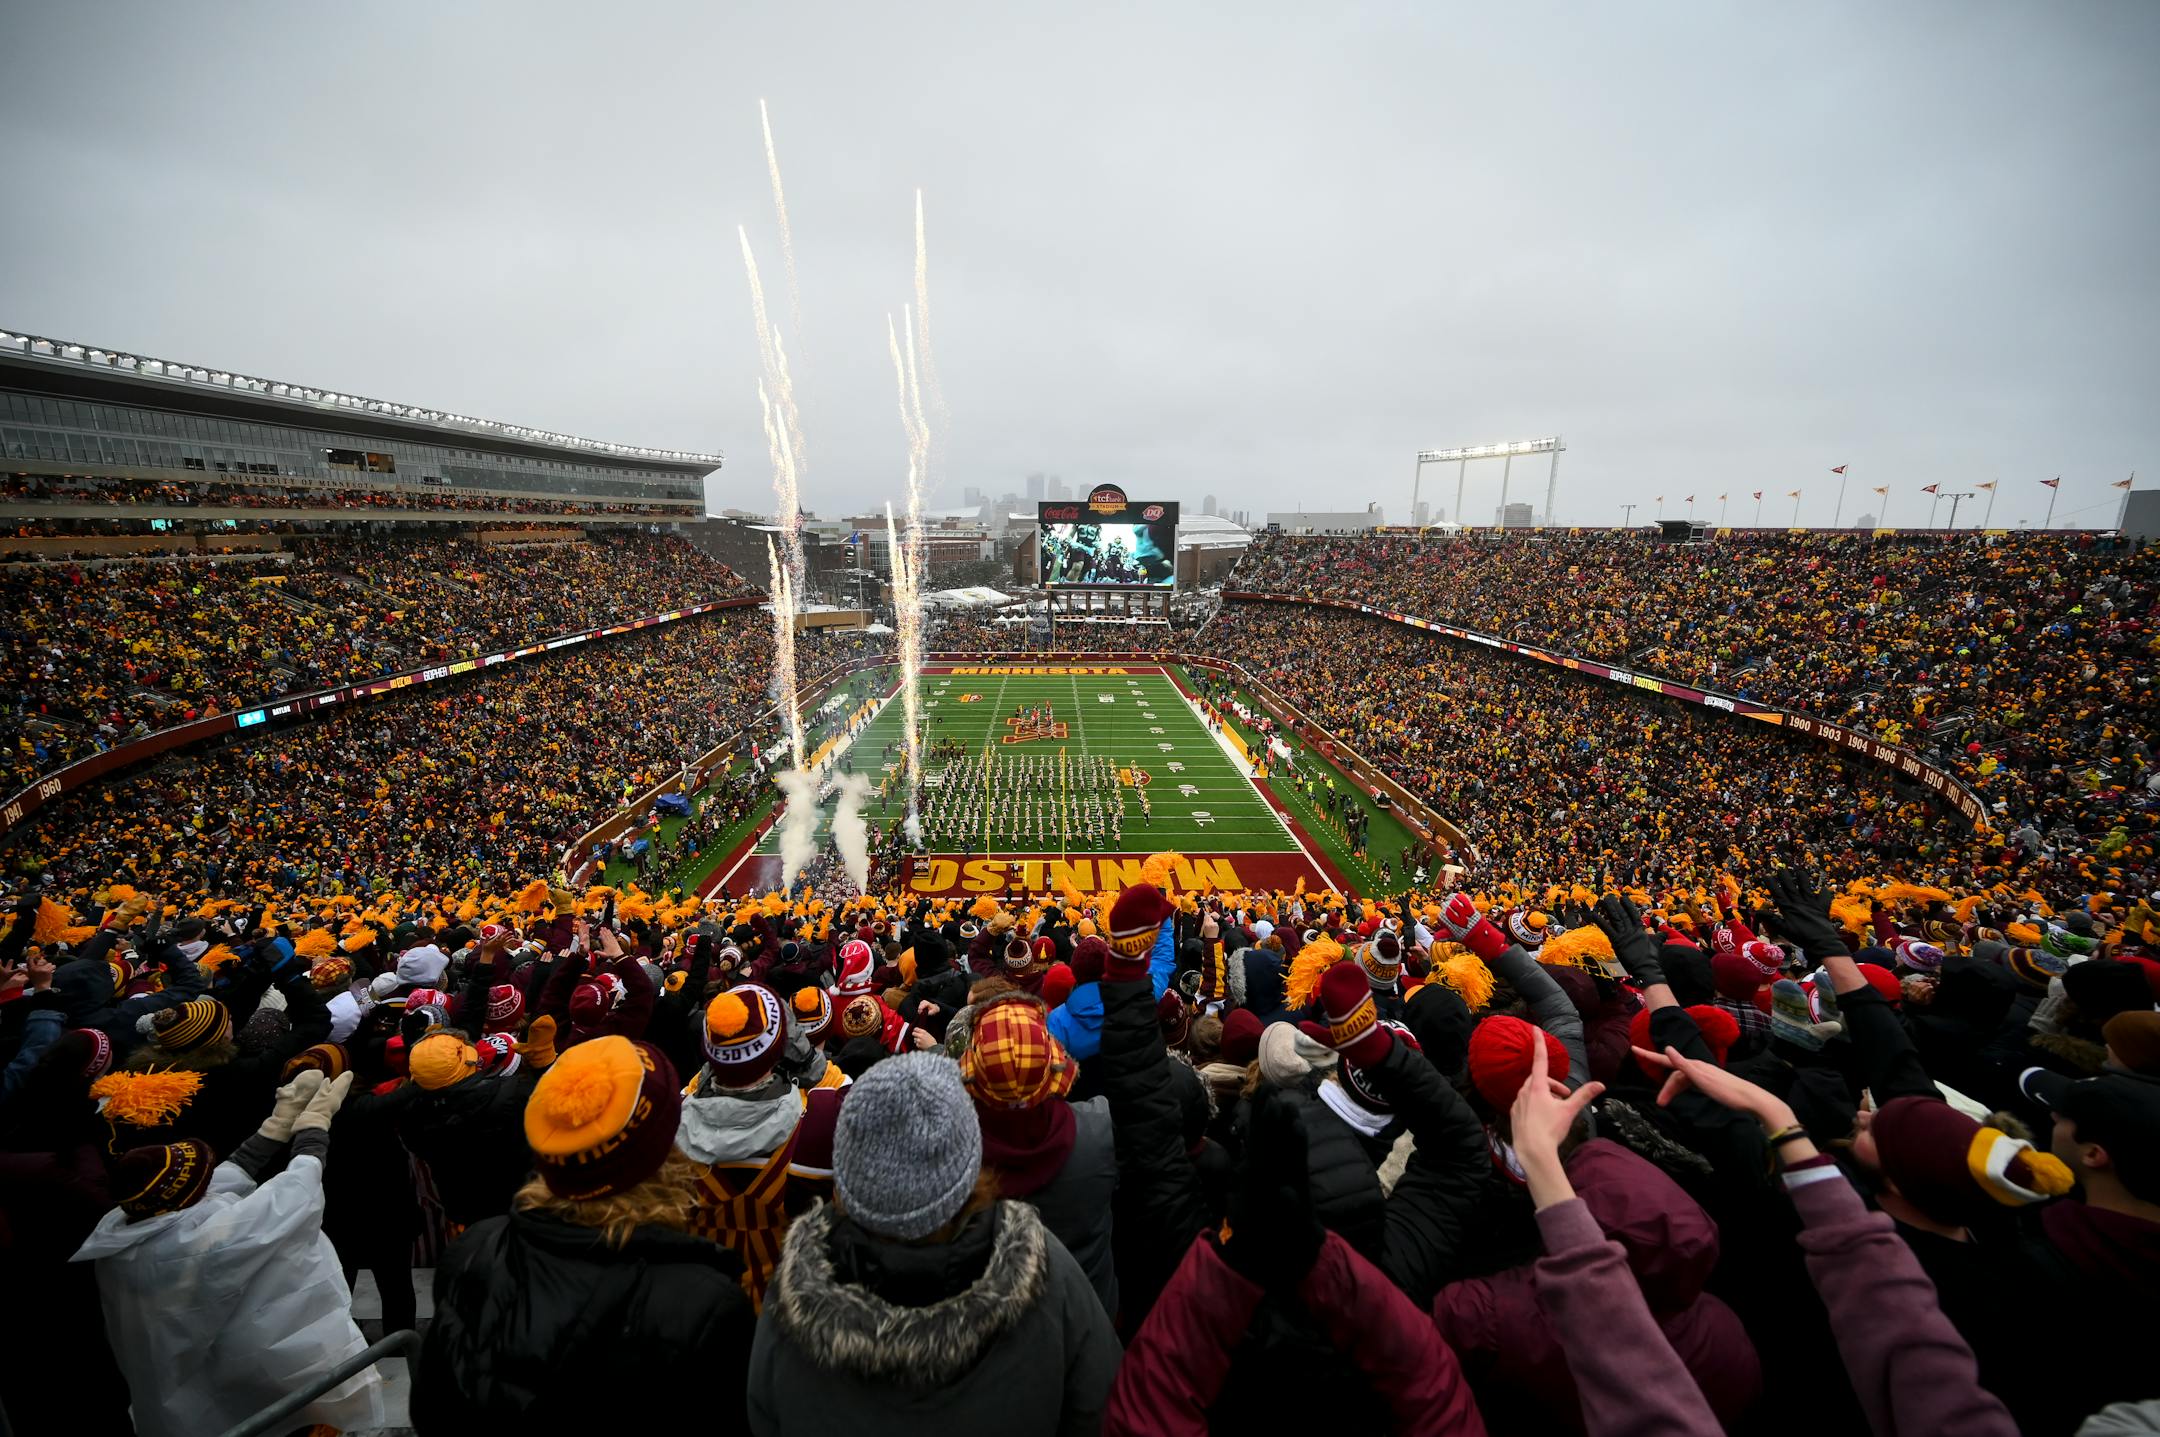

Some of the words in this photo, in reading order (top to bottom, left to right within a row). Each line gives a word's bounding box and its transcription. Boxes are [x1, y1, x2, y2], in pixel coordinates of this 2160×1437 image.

[220, 474, 296, 485] UNIVERSITY
[319, 480, 376, 489] MINNESOTA
[1097, 493, 1110, 502] tcf
[423, 667, 448, 682] GOPHER
[448, 659, 477, 676] FOOTBALL
[951, 667, 1129, 675] MINNESOTA
[1609, 669, 1632, 685] GOPHER
[1632, 675, 1664, 693] FOOTBALL
[1789, 715, 1811, 732] 1900
[1817, 724, 1841, 742] 1903
[1847, 734, 1868, 753] 1904
[1874, 746, 1897, 764] 1906
[1901, 756, 1921, 776] 1909
[1923, 768, 1944, 789] 1910
[1946, 782, 1960, 804] 1911
[1961, 796, 1977, 819] 1915
[39, 778, 62, 800] 1960
[4, 802, 23, 826] 1941
